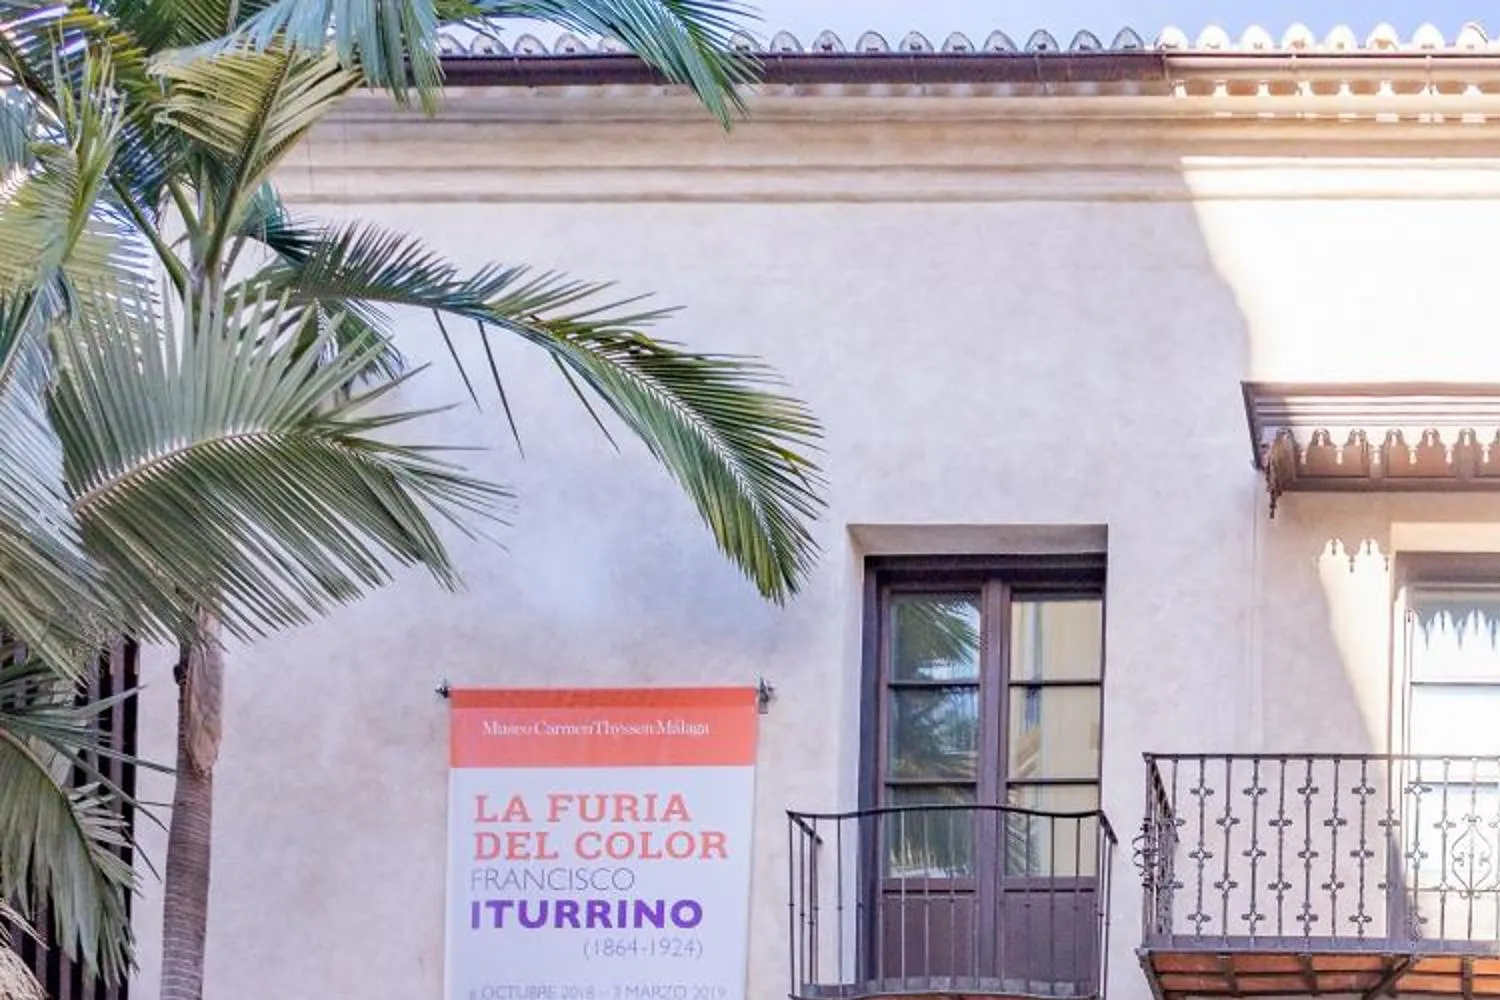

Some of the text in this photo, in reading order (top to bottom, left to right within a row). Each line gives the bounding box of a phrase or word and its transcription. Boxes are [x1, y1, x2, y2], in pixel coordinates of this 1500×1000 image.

[482, 719, 710, 739] Museo Carmen Thyssen Málaga
[474, 793, 693, 823] LA FURIA
[473, 830, 729, 861] DEL COLOR
[470, 867, 636, 892] FRANCISCO
[470, 899, 704, 929] ITURRINO
[583, 937, 704, 960] (1864-1924)
[481, 984, 558, 1000] OCTUBRE
[561, 984, 596, 1000] 2018
[625, 983, 688, 1000] MARZO
[693, 983, 727, 1000] 2019
